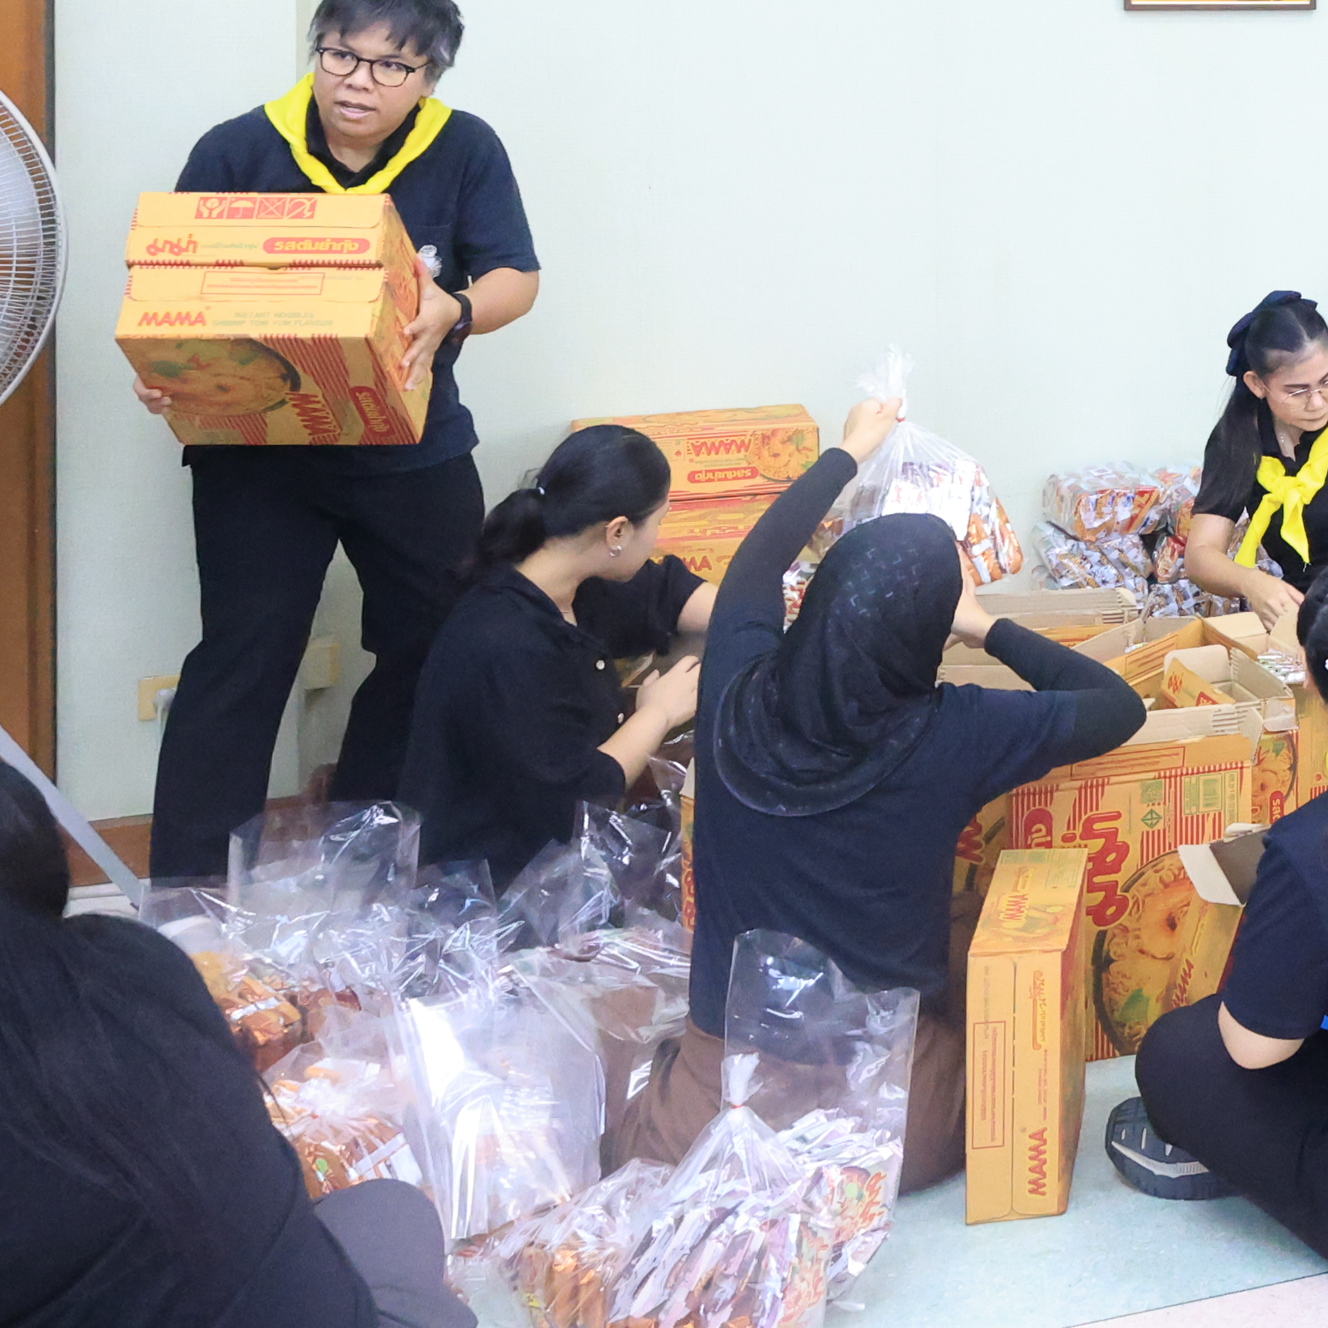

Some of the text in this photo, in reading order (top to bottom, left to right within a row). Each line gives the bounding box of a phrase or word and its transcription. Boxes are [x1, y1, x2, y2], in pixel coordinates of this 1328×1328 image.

[146, 234, 200, 256] มาม่า
[138, 312, 207, 328] MAMA
[284, 392, 340, 436] MAMA
[690, 439, 752, 457] MAMA
[1028, 1126, 1048, 1198] MAMA
